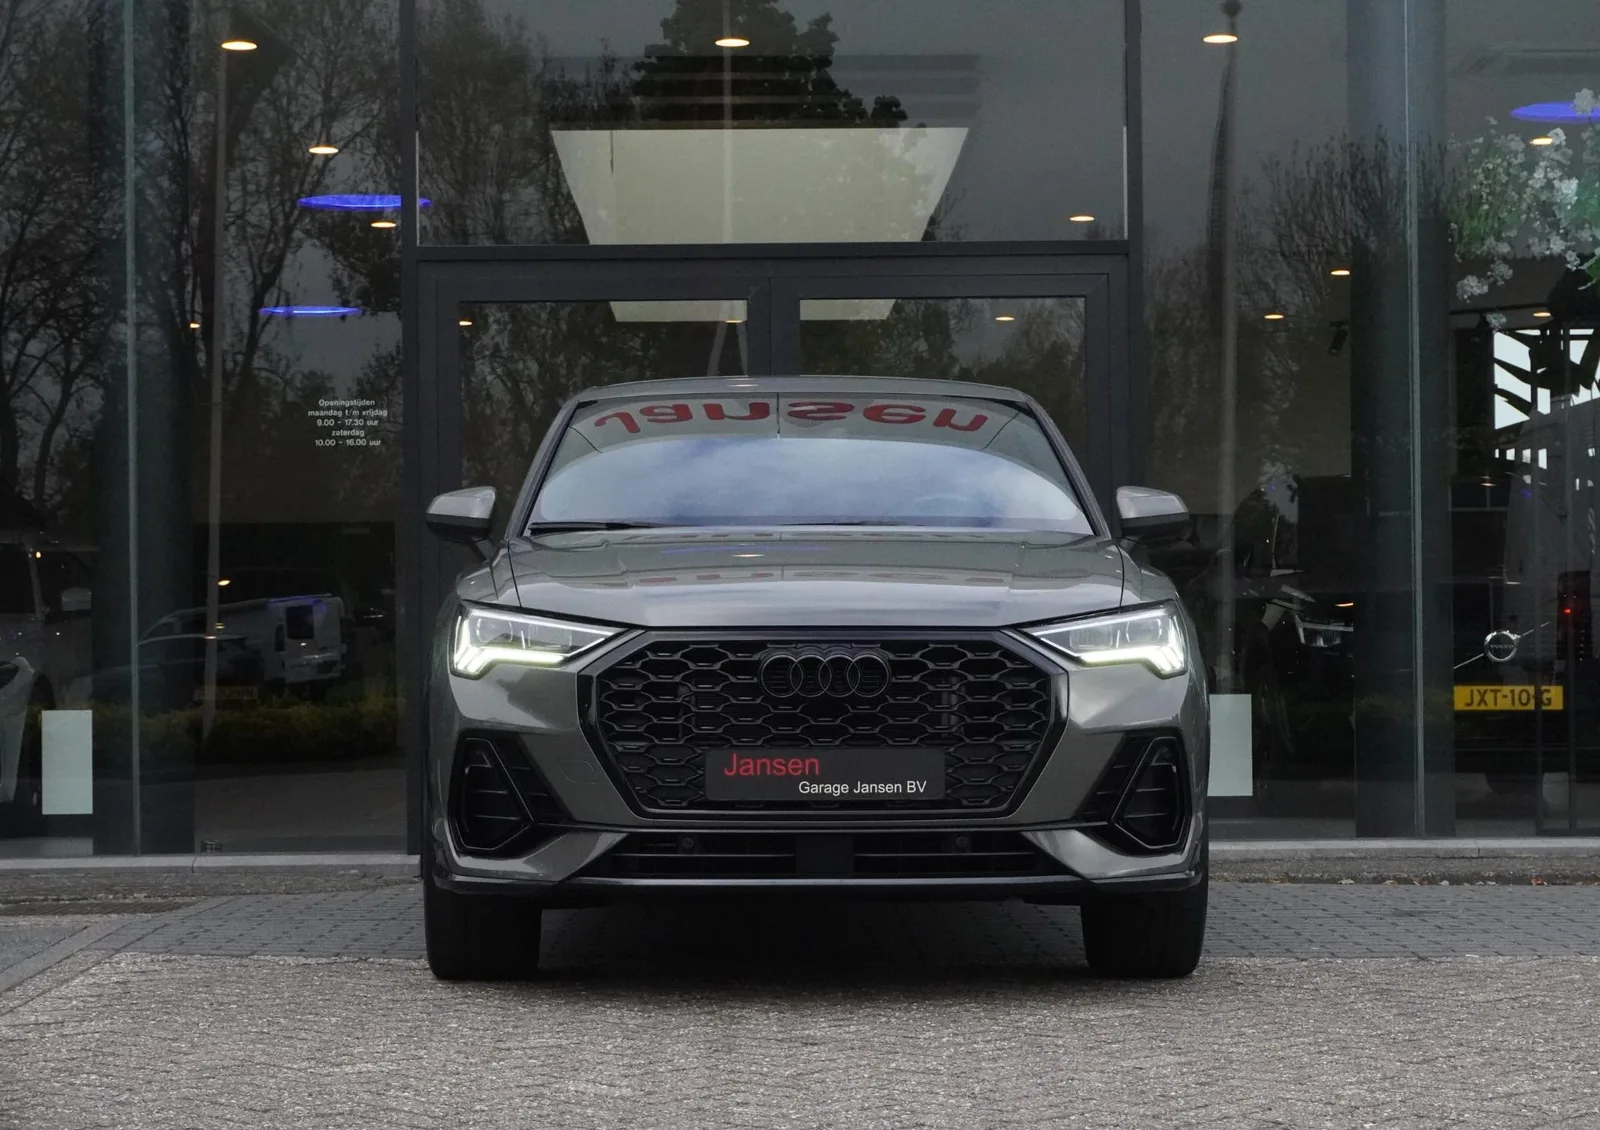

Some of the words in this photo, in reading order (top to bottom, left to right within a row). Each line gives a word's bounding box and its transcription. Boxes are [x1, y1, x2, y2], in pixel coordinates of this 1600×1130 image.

[318, 399, 376, 407] Openingstijden
[308, 409, 343, 417] maandag
[362, 409, 388, 417] vrijdag
[345, 418, 364, 426] 17.30
[331, 429, 365, 437] zaterdag
[346, 438, 367, 446] 16.00
[1464, 688, 1552, 707] JXT-10G
[724, 753, 820, 776] Jansen
[798, 780, 849, 796] Garage
[853, 781, 902, 794] Jansen
[906, 780, 927, 793] BV
